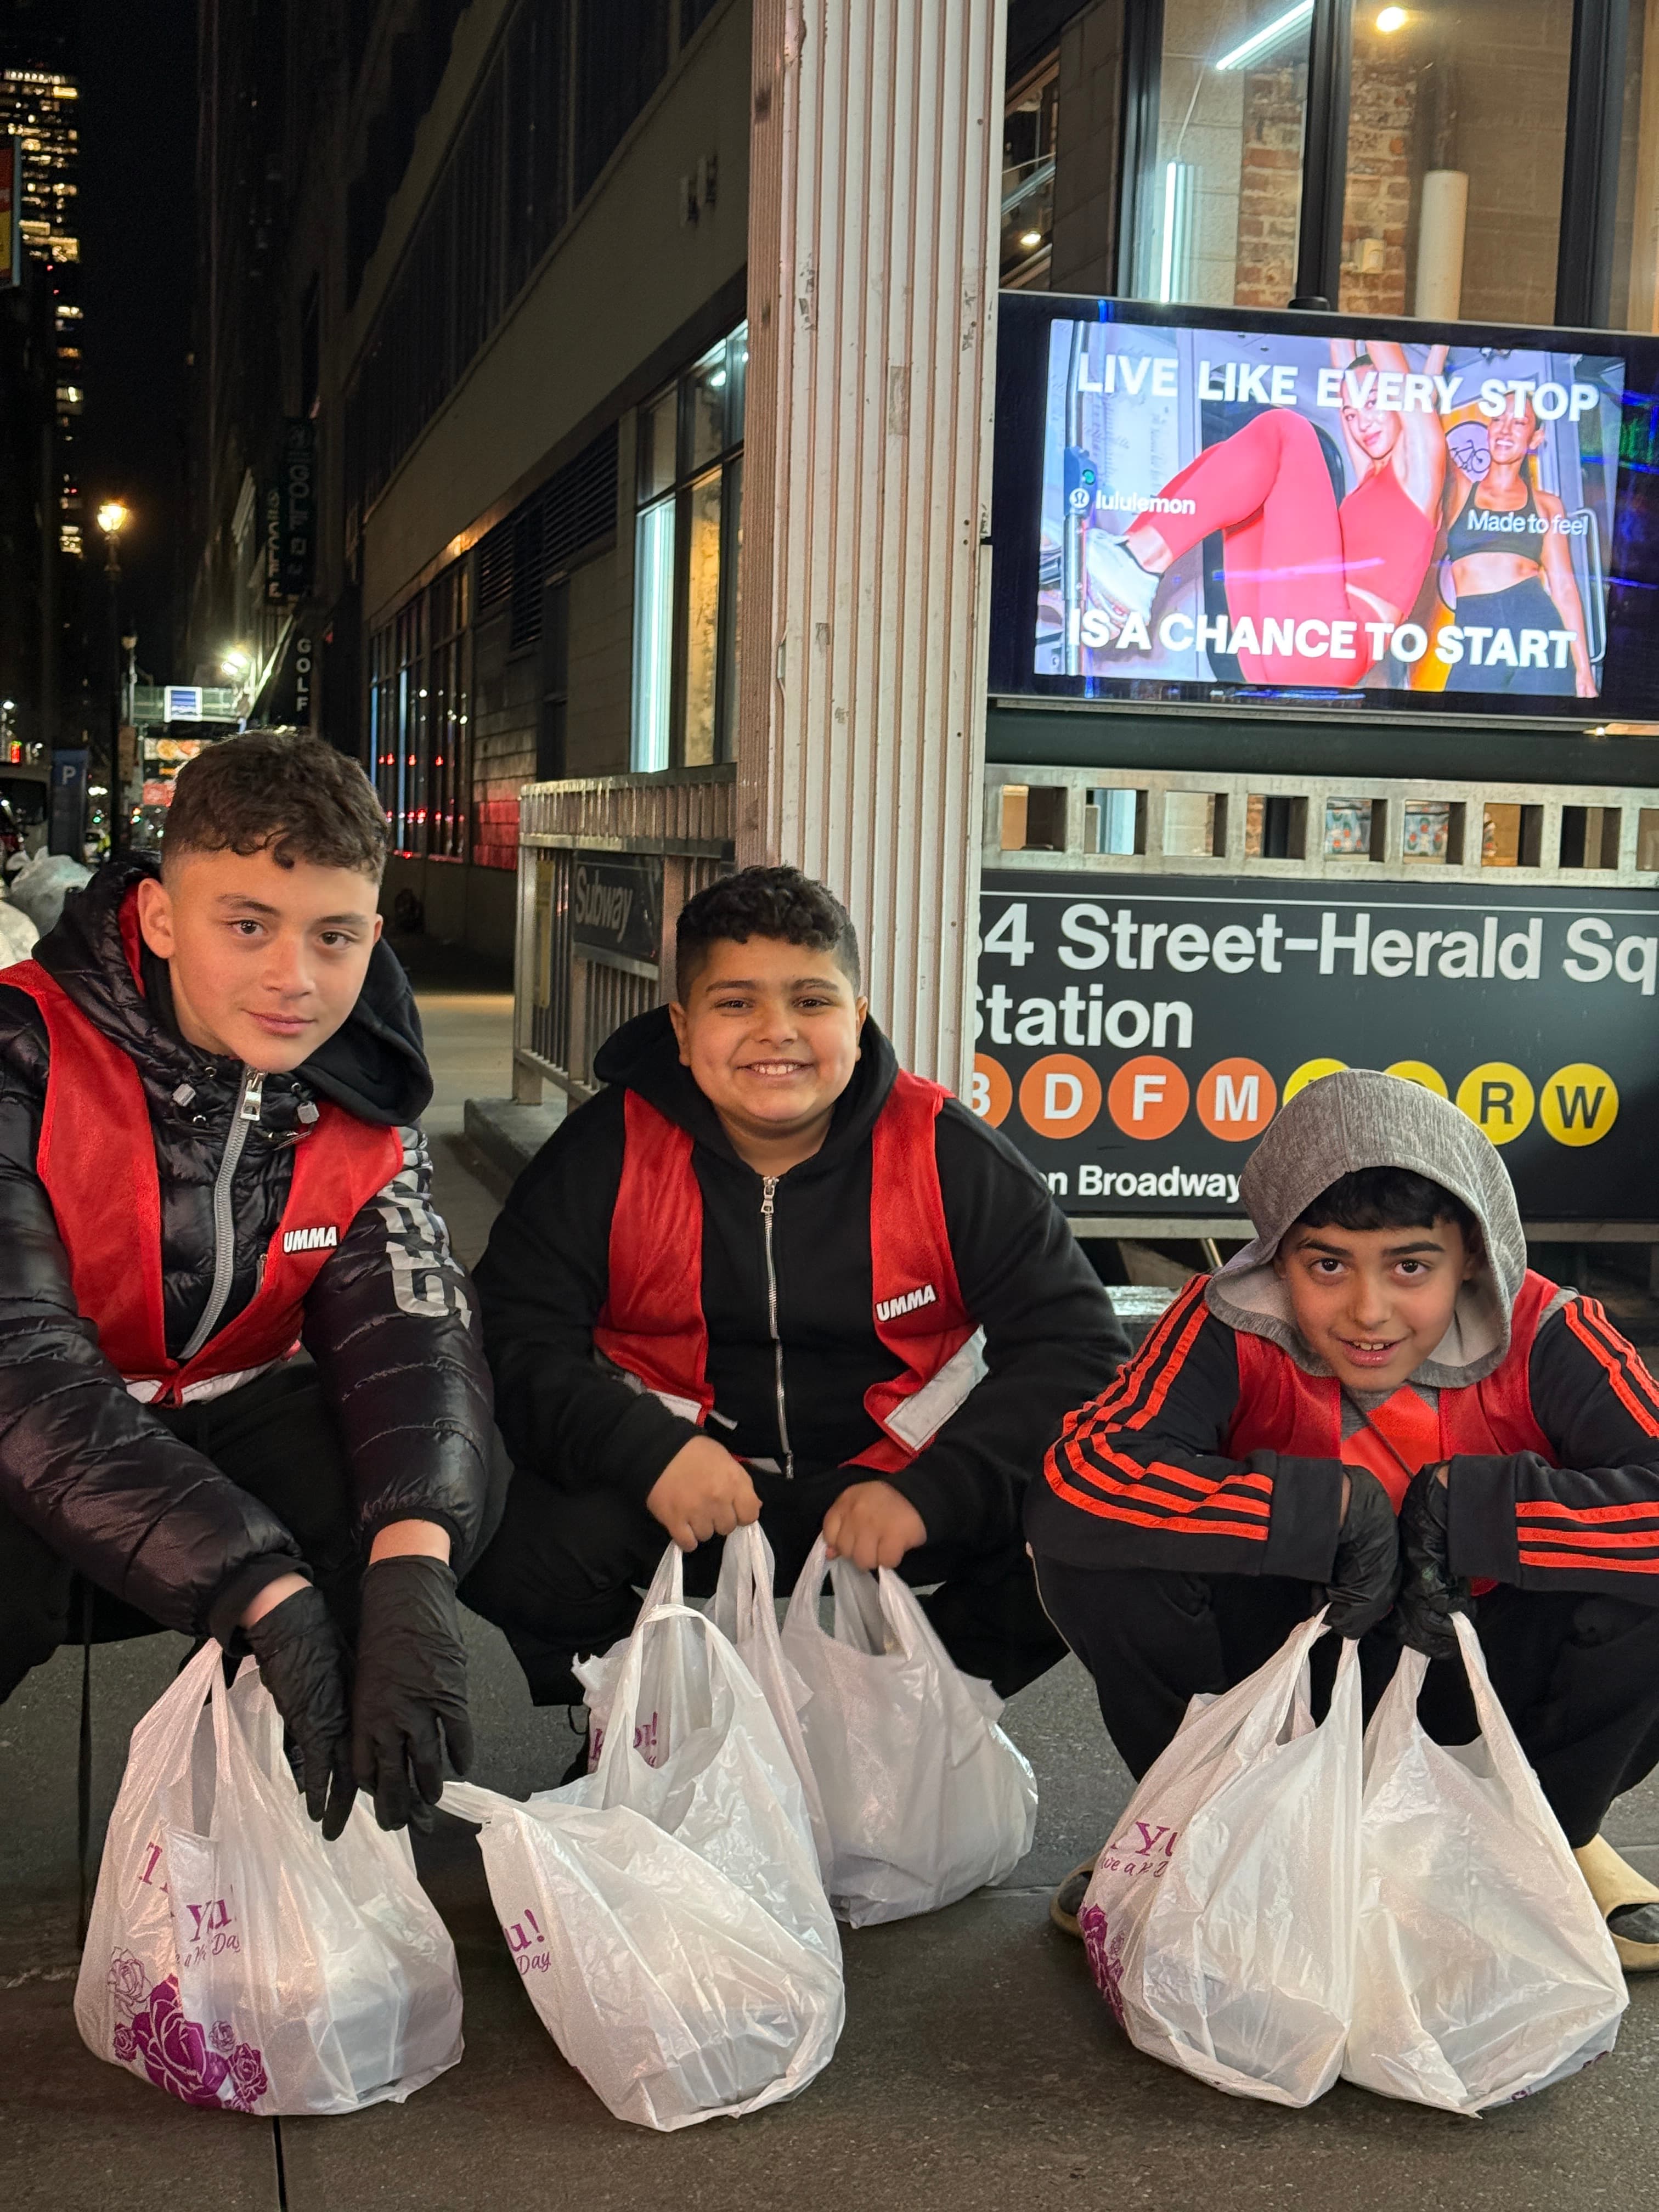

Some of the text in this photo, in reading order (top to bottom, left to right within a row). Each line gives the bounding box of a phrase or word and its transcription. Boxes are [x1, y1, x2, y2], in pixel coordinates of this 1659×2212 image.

[1077, 352, 1599, 422] LIVE LIKE EVERY STOP
[1096, 490, 1197, 515] lululemon
[1466, 509, 1589, 535] Made to feel
[1068, 608, 1577, 669] IS A CHANCE TO START
[296, 637, 312, 712] GOLF
[62, 765, 76, 785] P
[575, 866, 633, 943] Subway
[978, 902, 1035, 967] 4
[1563, 917, 1658, 996] Sq
[974, 984, 1193, 1048] tation
[1044, 1073, 1083, 1119] D
[1132, 1075, 1167, 1120] F
[1215, 1075, 1259, 1121] M
[1480, 1081, 1515, 1124] R
[1555, 1086, 1606, 1129] W
[1078, 1165, 1242, 1204] Broadway
[283, 1226, 337, 1252] UMMA
[876, 1284, 936, 1322] UMMA
[516, 1951, 551, 1975] Day
